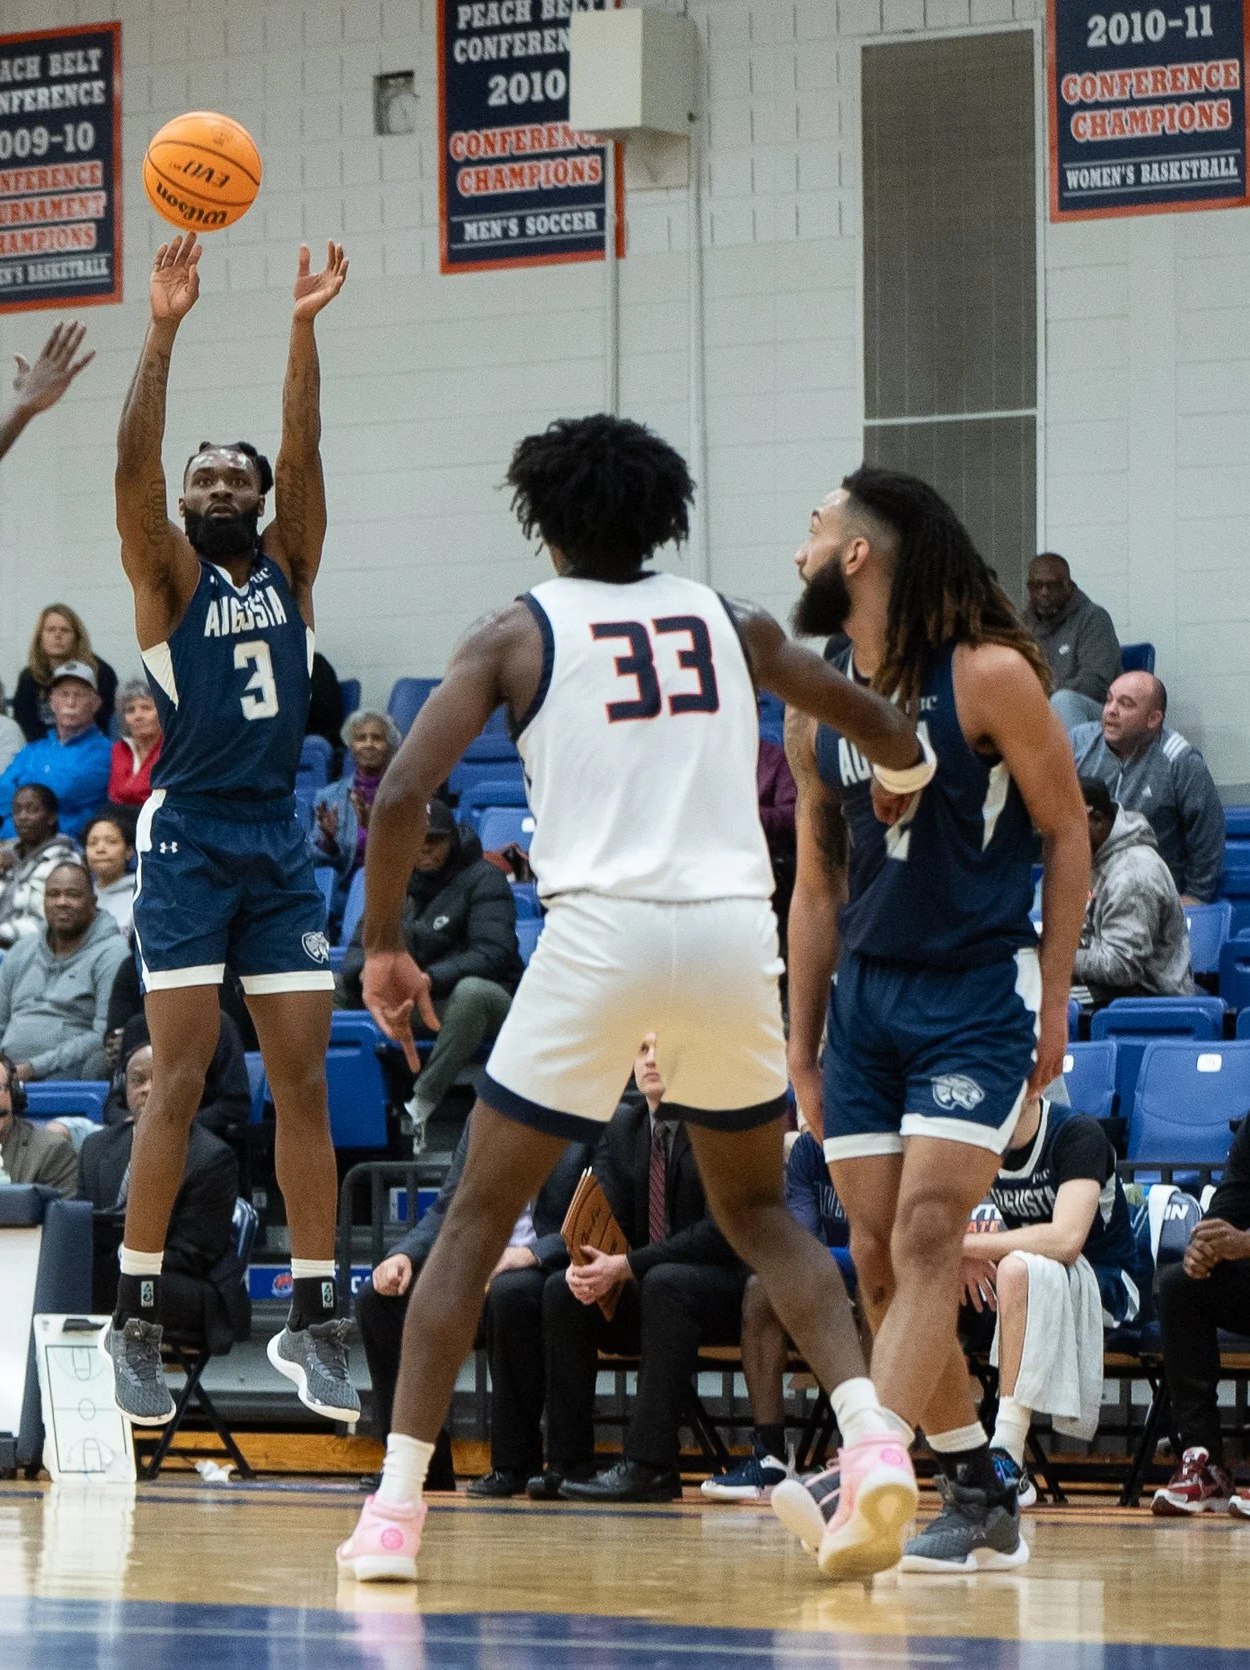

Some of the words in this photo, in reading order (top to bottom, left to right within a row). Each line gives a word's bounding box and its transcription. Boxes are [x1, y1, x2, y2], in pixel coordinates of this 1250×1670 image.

[457, 1, 531, 30] PEACH
[1086, 4, 1214, 48] 2010-11
[49, 48, 101, 77] BELT
[1061, 58, 1240, 105] CONFERENCE
[487, 68, 567, 107] 2010
[1070, 99, 1232, 143] CHAMPIONS
[457, 155, 602, 198] CHAMPIONS
[1066, 164, 1134, 190] WOMEN'S
[1141, 156, 1239, 184] BASKETBALL
[464, 216, 519, 241] MEN'S
[525, 211, 597, 236] SOCCER
[28, 258, 109, 284] BASKETBALL
[234, 640, 279, 720] 3
[589, 613, 719, 724] 33
